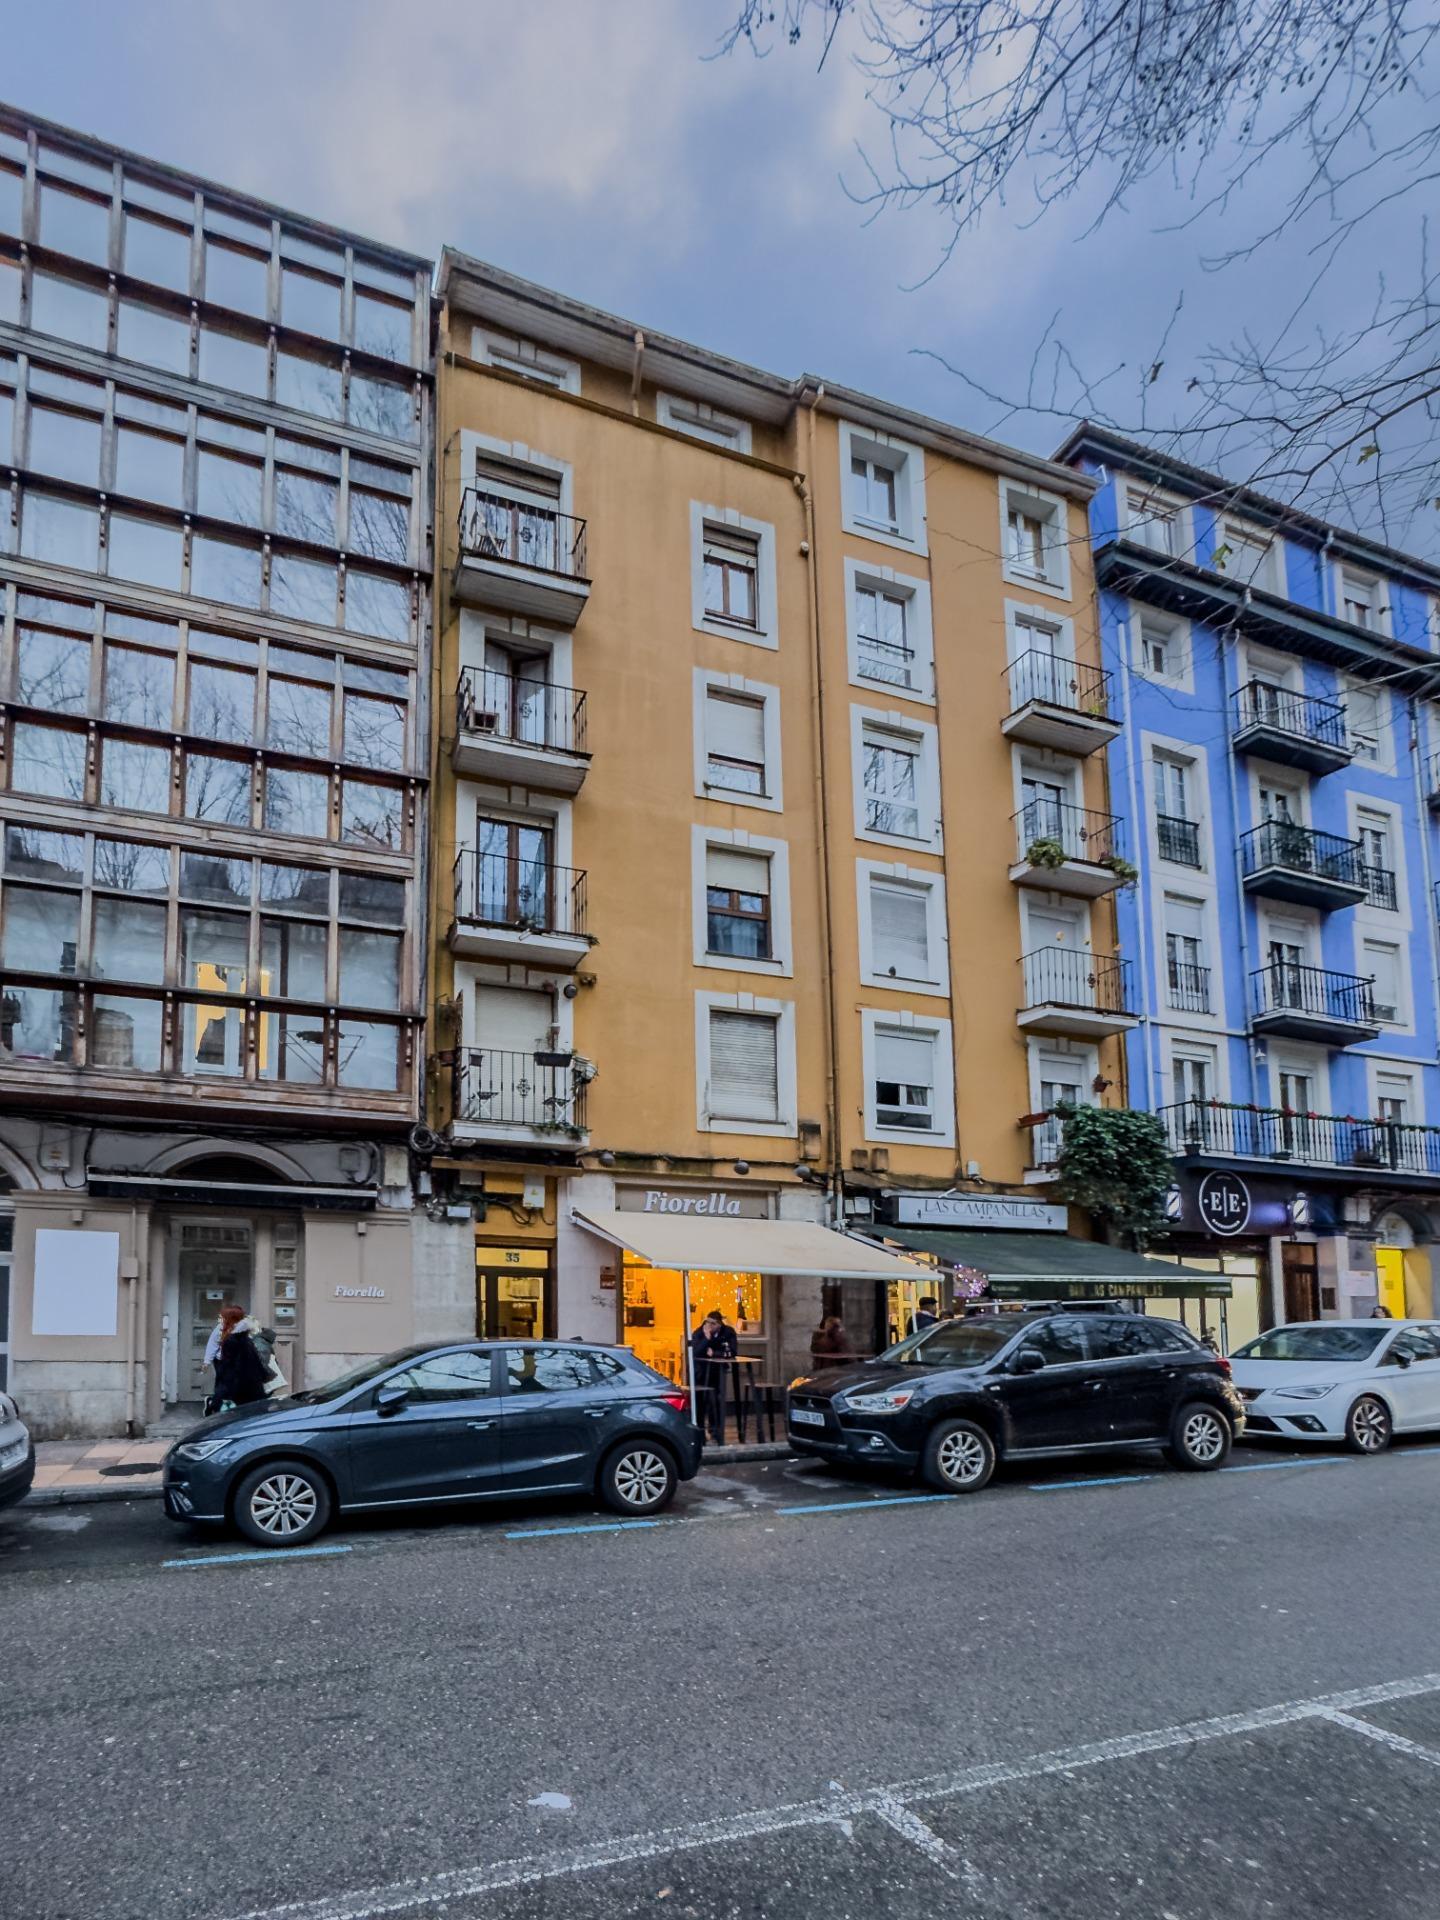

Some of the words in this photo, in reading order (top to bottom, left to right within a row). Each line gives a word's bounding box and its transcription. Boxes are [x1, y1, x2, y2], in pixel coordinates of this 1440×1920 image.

[643, 1190, 740, 1215] Fiorella
[924, 1199, 949, 1213] LAS
[953, 1201, 1045, 1218] CAMPANILLAS
[505, 1252, 520, 1263] 35
[334, 1285, 385, 1297] Fiorella
